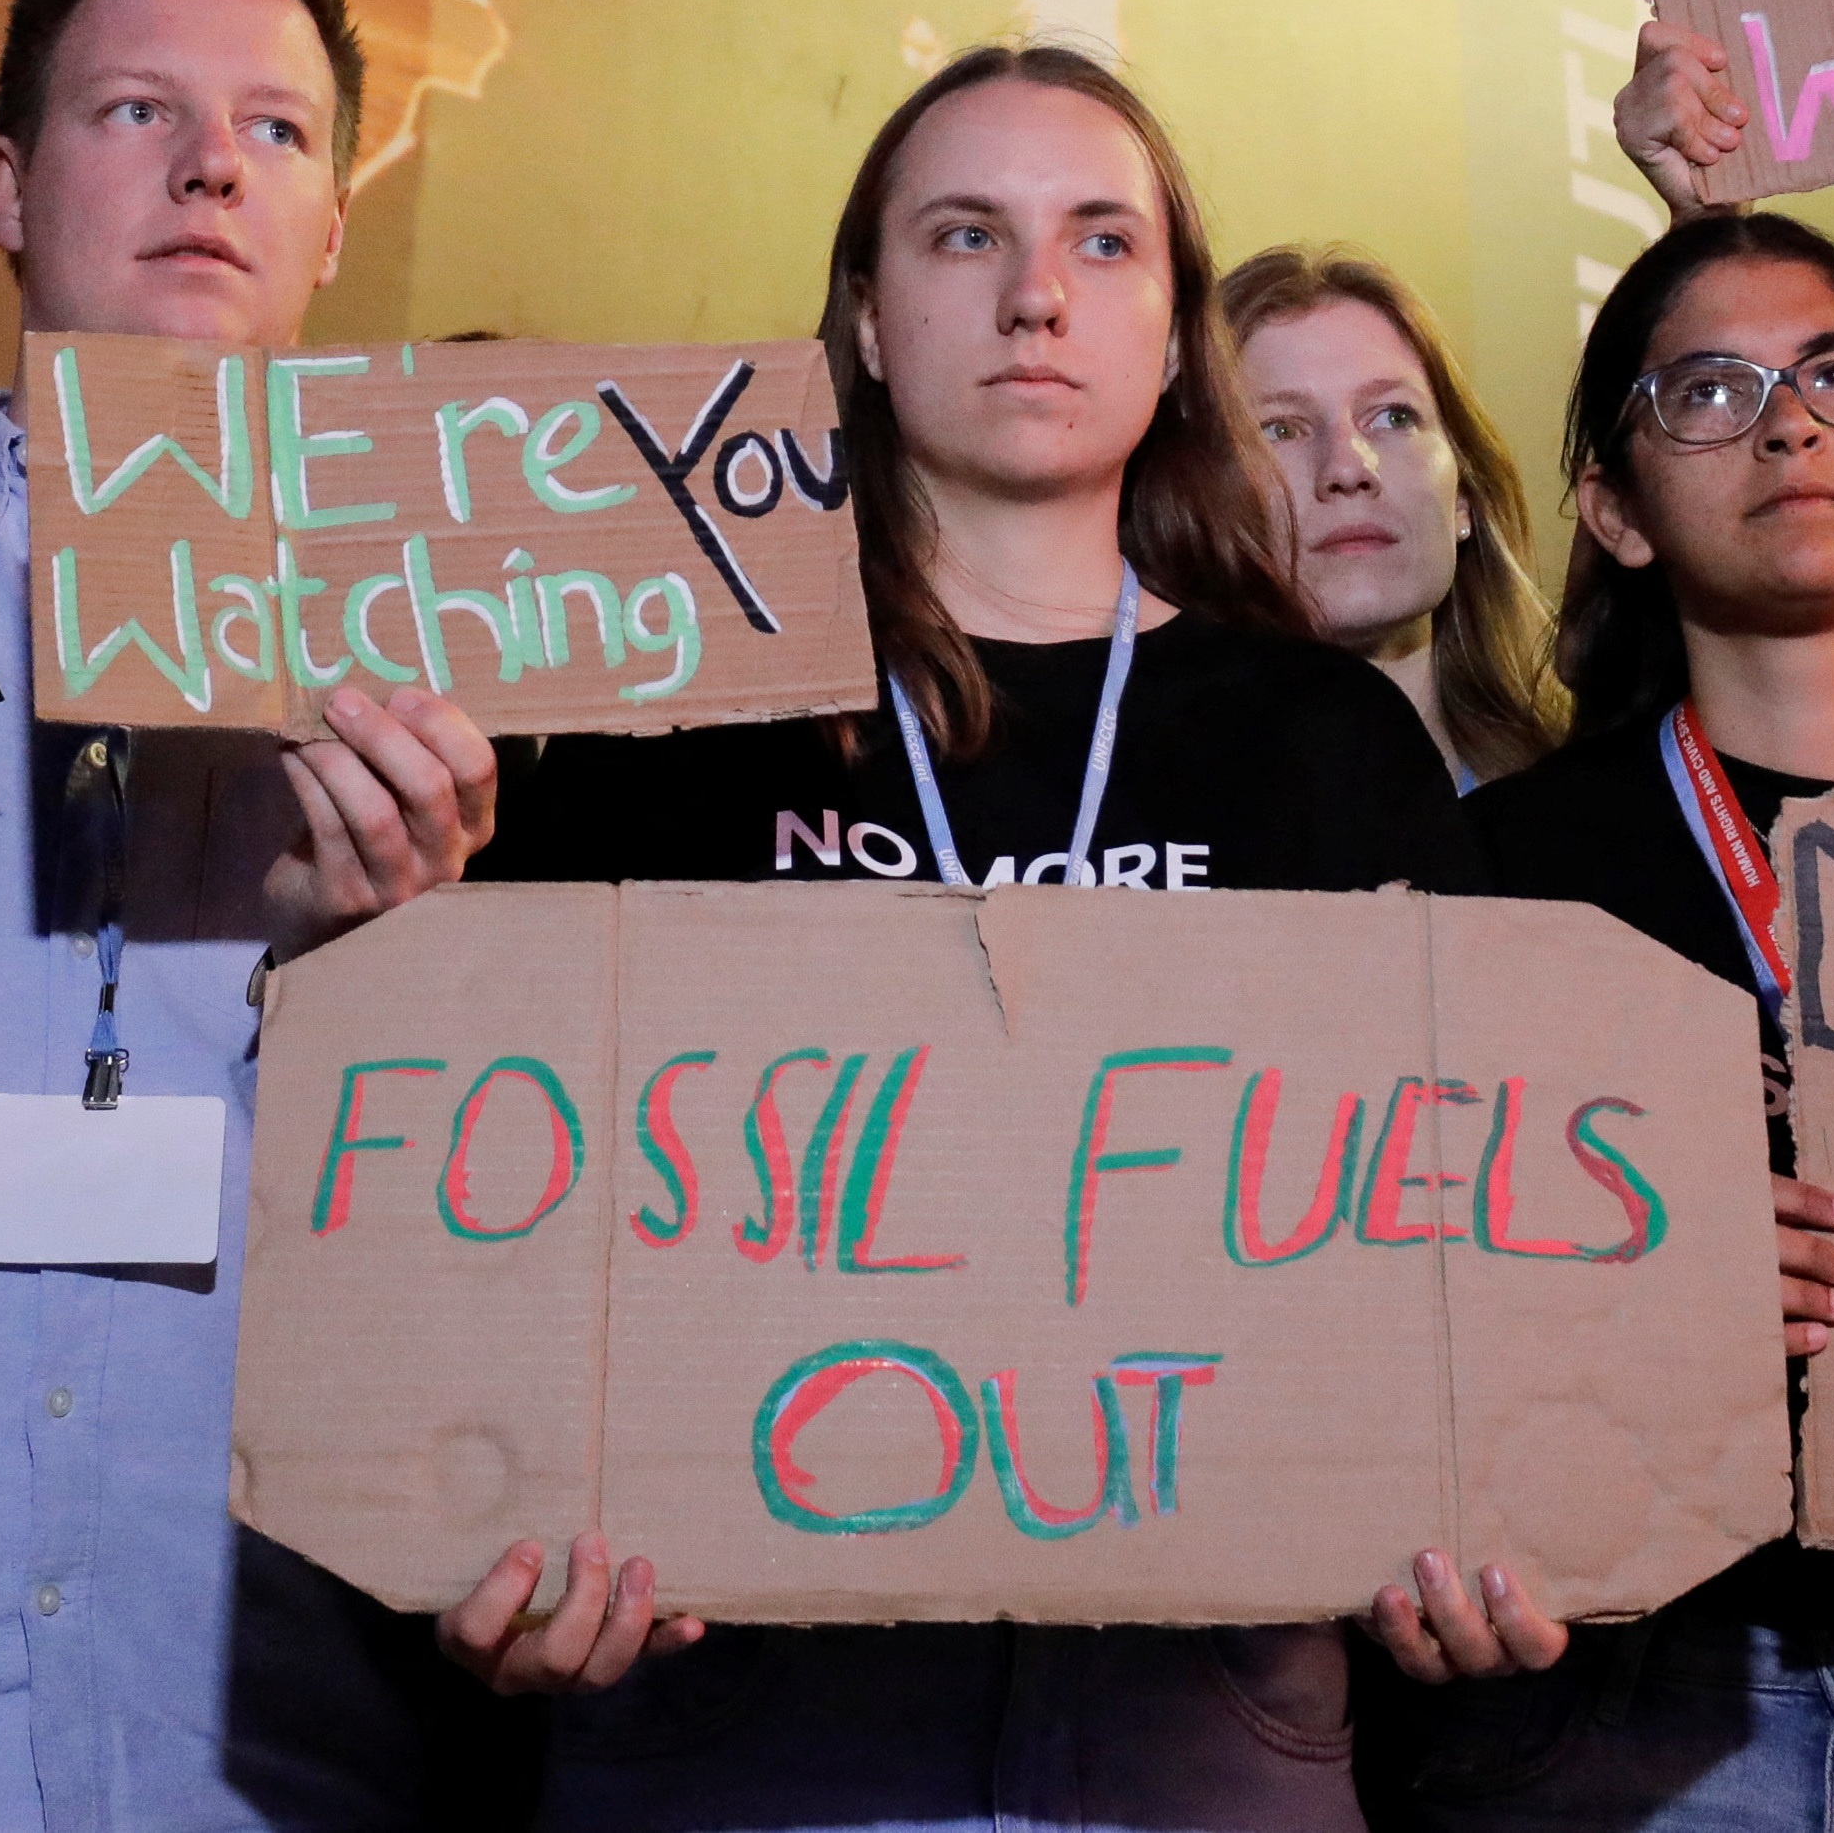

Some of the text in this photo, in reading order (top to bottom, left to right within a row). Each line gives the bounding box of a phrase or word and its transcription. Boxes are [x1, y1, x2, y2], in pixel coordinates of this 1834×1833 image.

[596, 358, 850, 634] You
[52, 532, 702, 713] Watching
[900, 710, 931, 784] unfccc.int
[1091, 707, 1117, 772] UNFCCC
[1682, 739, 1705, 771] CIVIC
[1698, 770, 1719, 796] AND
[1710, 794, 1740, 840] RIGHTS
[775, 807, 918, 878] NO
[1730, 839, 1761, 888] HUMAN
[308, 1044, 1667, 1307] FOSSIL FUELS
[752, 1337, 1225, 1540] OUT
